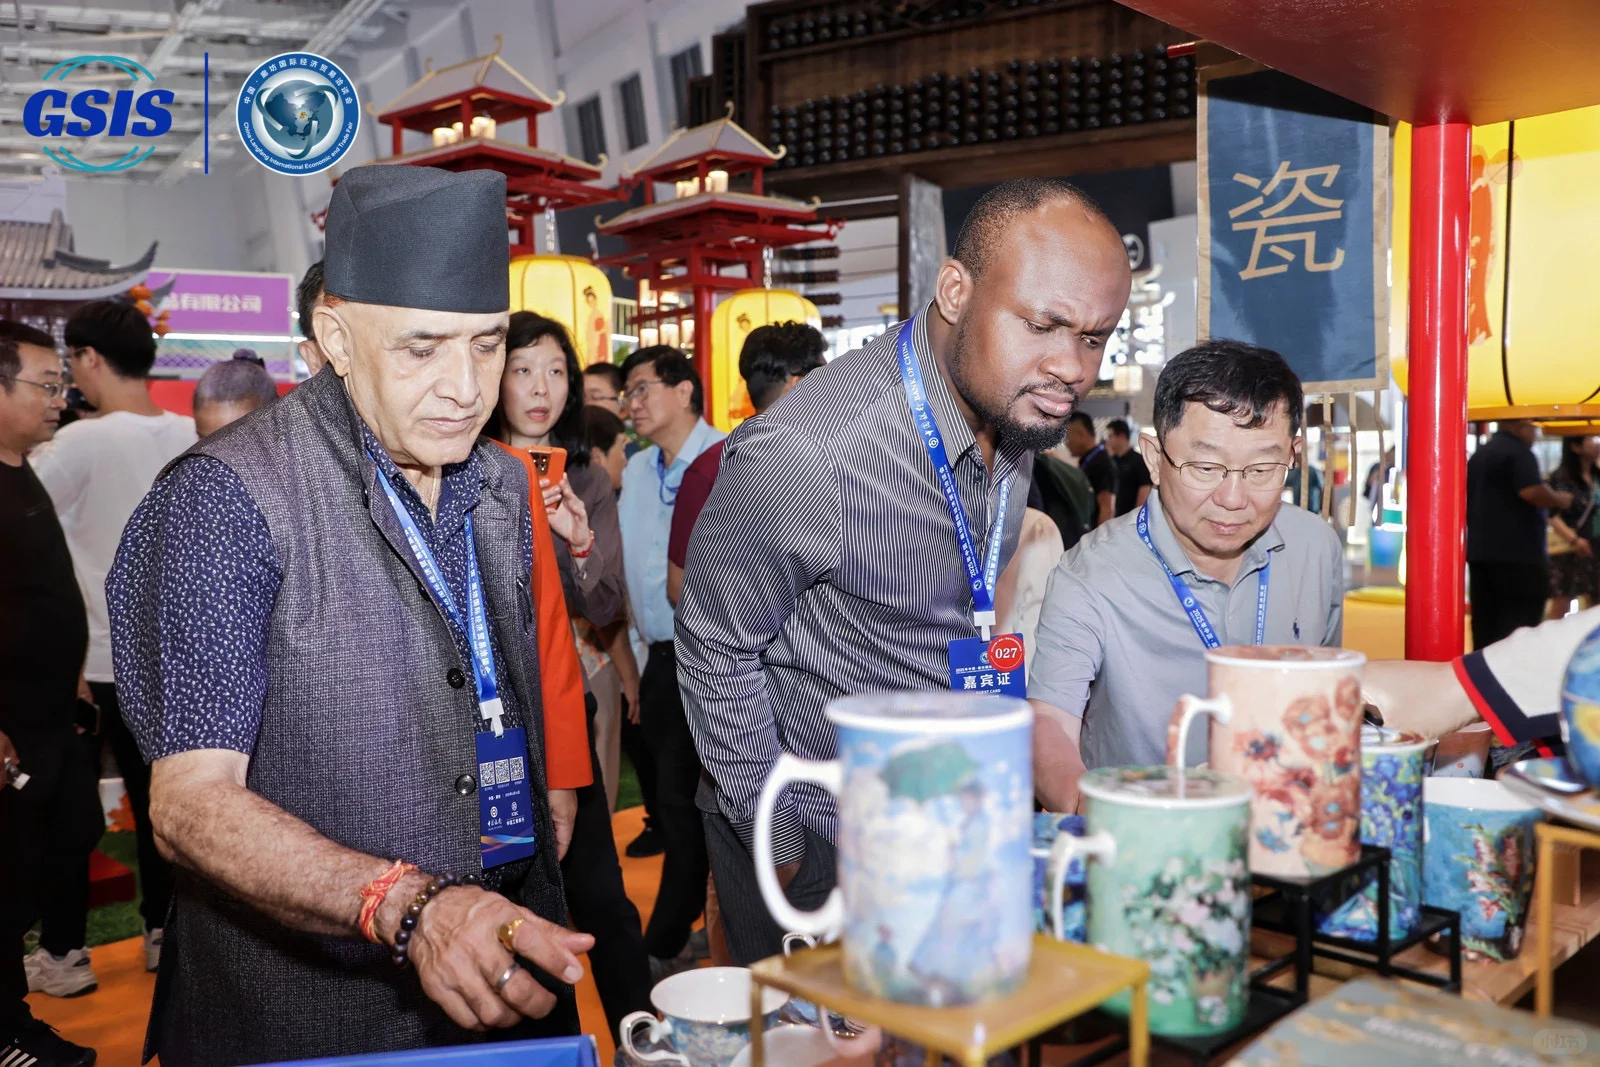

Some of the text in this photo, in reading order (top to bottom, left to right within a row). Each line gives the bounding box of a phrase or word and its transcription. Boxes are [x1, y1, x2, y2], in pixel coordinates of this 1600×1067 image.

[1228, 160, 1345, 281] 瓷
[901, 341, 921, 403] BANK OF CHINA
[995, 647, 1018, 659] 027
[963, 672, 1011, 690] 嘉宾证
